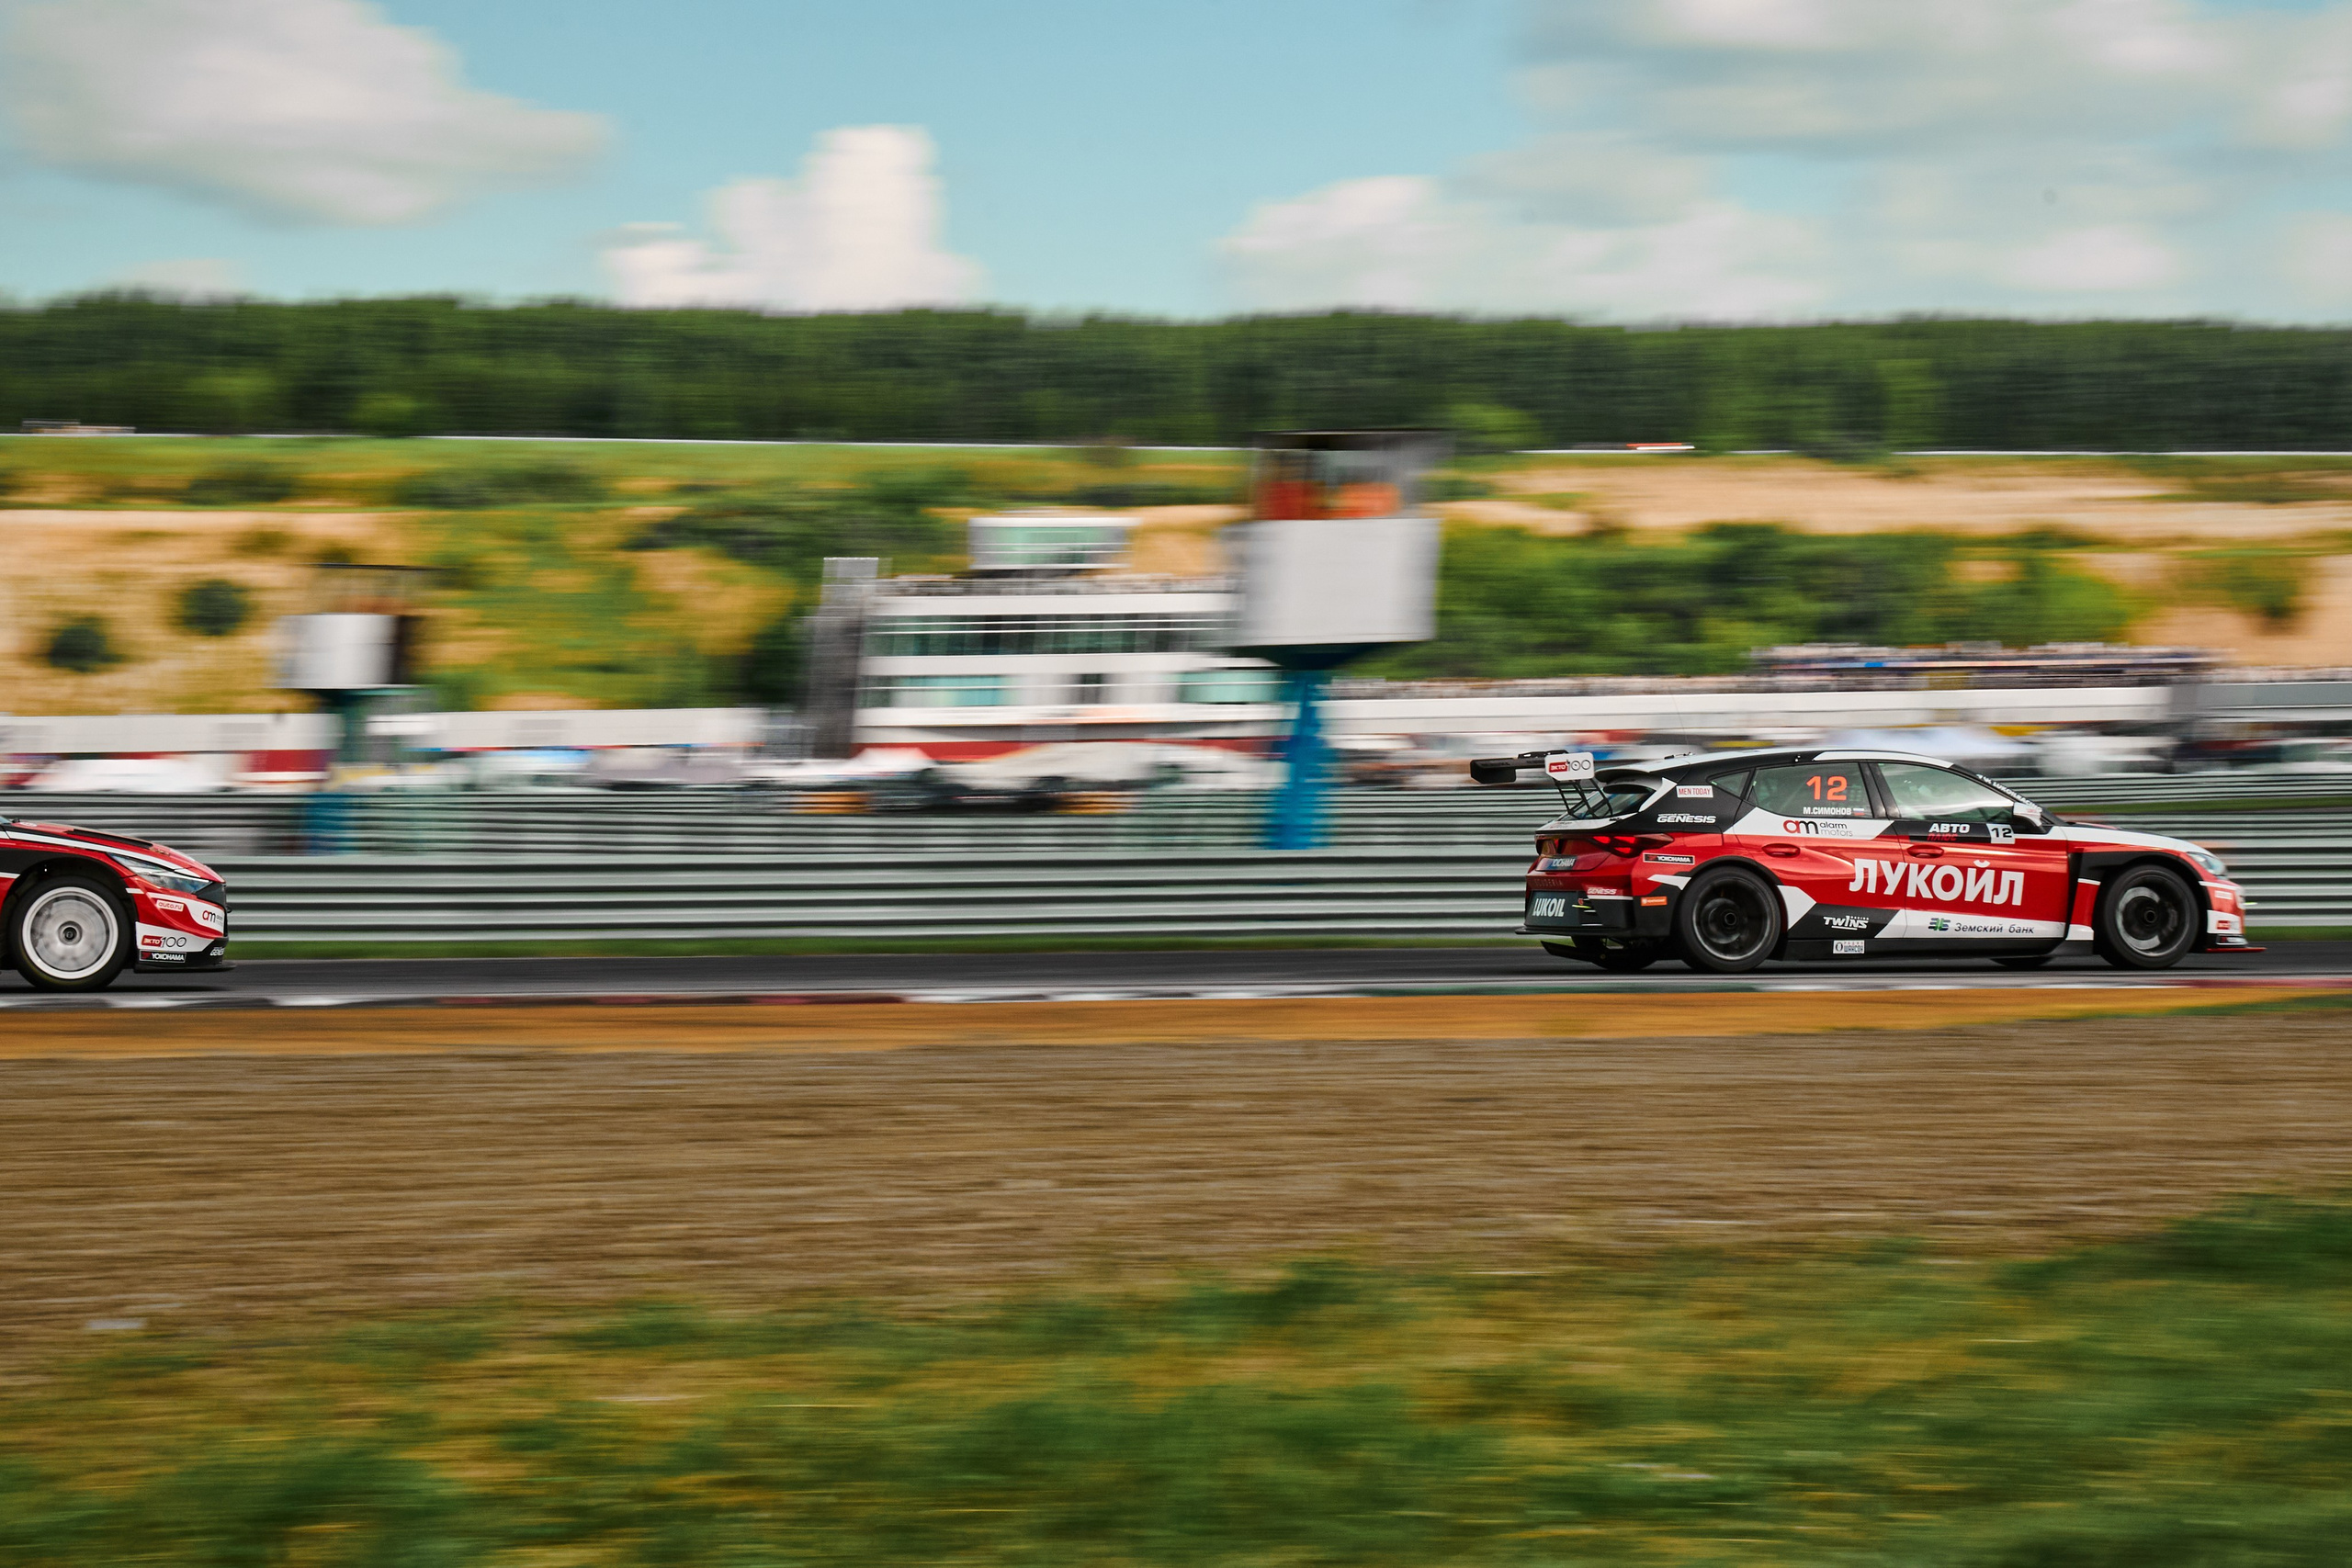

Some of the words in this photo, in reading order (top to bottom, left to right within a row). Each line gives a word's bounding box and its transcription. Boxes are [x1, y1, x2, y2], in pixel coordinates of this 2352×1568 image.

[1806, 775, 1848, 801] 12
[1657, 815, 1716, 824] GENESIS
[1820, 821, 1848, 829] alarm
[1928, 823, 1971, 833] АВТО
[1821, 829, 1853, 837] motors
[1991, 828, 2012, 838] 12
[1849, 858, 2024, 906] ЛУКОЙЛ
[158, 902, 182, 910] auto.ru
[1532, 897, 1566, 917] LUKOIL
[1954, 922, 2003, 933] Земский
[2008, 923, 2034, 934] банк
[152, 953, 184, 961] YOKOHAMA
